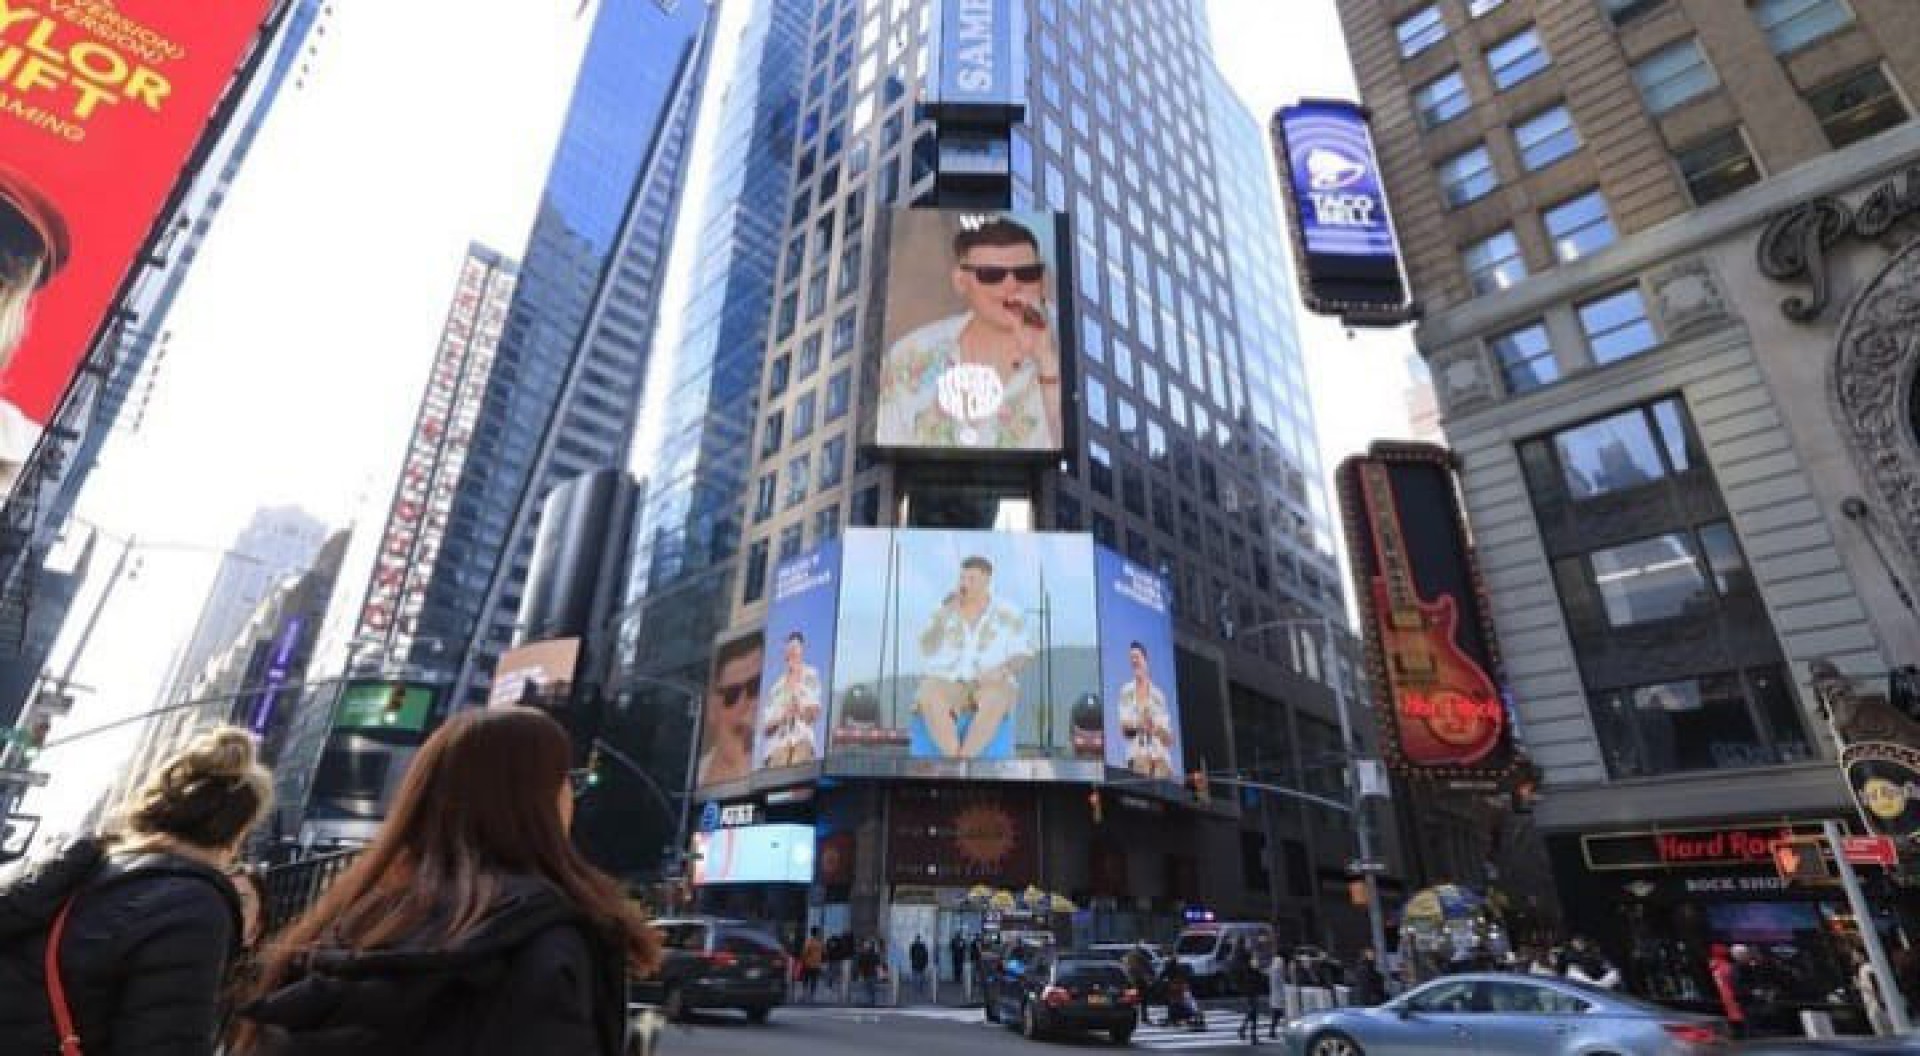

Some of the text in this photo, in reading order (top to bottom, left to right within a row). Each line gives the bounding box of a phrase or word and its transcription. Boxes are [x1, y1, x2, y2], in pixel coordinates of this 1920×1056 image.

[1308, 191, 1374, 211] TACO
[1314, 207, 1377, 226] BELL
[721, 803, 755, 825] AT&T
[1657, 831, 1724, 861] Hard
[1685, 878, 1736, 892] ROCK
